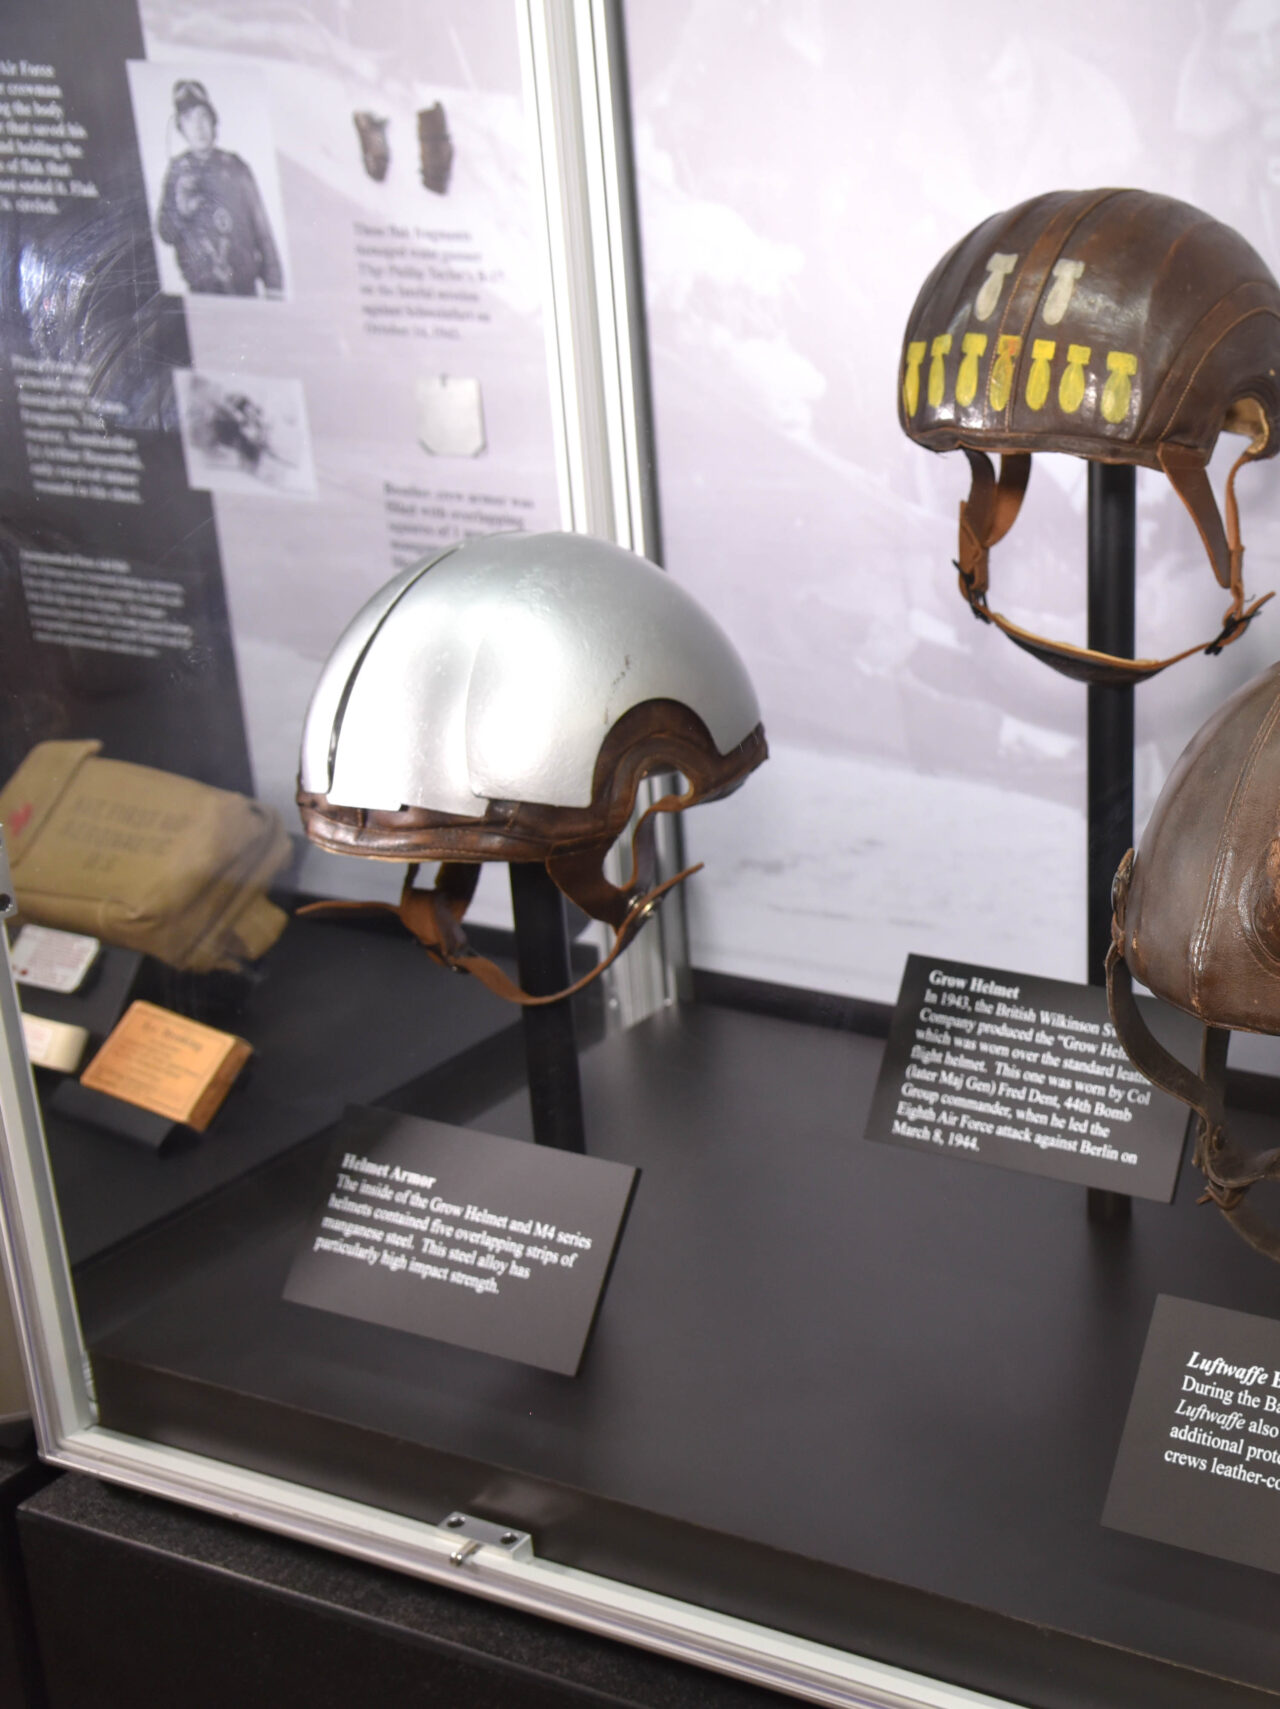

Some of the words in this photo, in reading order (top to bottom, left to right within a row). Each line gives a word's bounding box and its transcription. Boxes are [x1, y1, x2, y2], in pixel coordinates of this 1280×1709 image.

[928, 969, 966, 988] Grow
[970, 977, 1019, 999] Helmet
[919, 1007, 975, 1033] Company
[977, 1022, 1033, 1041] produced
[1035, 1030, 1054, 1046] the
[924, 988, 937, 1003] In
[974, 999, 993, 1014] the
[996, 1003, 1036, 1021] British
[1039, 1010, 1100, 1034] Wilkinson
[915, 1027, 950, 1044] which
[954, 1037, 976, 1050] was
[979, 1042, 1009, 1057] worn
[1011, 1049, 1040, 1062] over
[1040, 1051, 1061, 1067] the
[1062, 1058, 1115, 1077] standard
[905, 1064, 937, 1081] (later
[939, 1070, 963, 1089] Maj
[965, 1076, 996, 1094] Gen)
[997, 1082, 1026, 1100] Fred
[1063, 1096, 1091, 1113] 44th
[1094, 1102, 1132, 1122] Bomb
[910, 1044, 942, 1063] flight
[995, 1061, 1020, 1078] This
[1022, 1071, 1045, 1084] one
[1048, 1076, 1071, 1089] was
[1074, 1081, 1106, 1096] worn
[1108, 1084, 1124, 1101] by
[1127, 1088, 1151, 1105] Col
[891, 1119, 930, 1140] March
[896, 1100, 935, 1121] Eighth
[937, 1111, 957, 1125] Air
[959, 1114, 994, 1134] Force
[995, 1125, 1031, 1142] attack
[1033, 1134, 1077, 1152] against
[1079, 1140, 1118, 1160] Berlin
[1120, 1152, 1137, 1164] on
[900, 1082, 939, 1103] Group
[1016, 1108, 1048, 1124] when
[1050, 1113, 1066, 1128] he
[1068, 1116, 1088, 1133] led
[1090, 1122, 1110, 1138] the
[341, 1152, 390, 1176] Helmet
[390, 1166, 436, 1188] Armor
[327, 1193, 372, 1216] helmets
[373, 1208, 429, 1230] contained
[430, 1218, 454, 1237] five
[454, 1228, 524, 1258] overlapping
[525, 1246, 558, 1265] strips
[559, 1252, 578, 1267] of
[336, 1173, 358, 1191] The
[359, 1183, 393, 1200] inside
[394, 1190, 411, 1203] of
[409, 1192, 429, 1208] the
[429, 1196, 464, 1216] Grow
[464, 1204, 508, 1228] Helmet
[508, 1219, 533, 1234] and
[533, 1221, 555, 1239] M4
[556, 1231, 592, 1249] series
[313, 1236, 378, 1265] particularly
[379, 1252, 407, 1271] high
[408, 1260, 448, 1280] impact
[321, 1216, 384, 1241] manganese
[422, 1238, 446, 1257] This
[448, 1249, 476, 1264] steel
[477, 1255, 507, 1276] alloy
[508, 1261, 530, 1279] has
[1186, 1351, 1268, 1385] Luftwaffe
[1181, 1375, 1233, 1405] During
[1237, 1389, 1260, 1408] the
[1169, 1424, 1244, 1454] additional
[1174, 1398, 1246, 1430] Luftwaffe
[1248, 1418, 1279, 1437] also
[1164, 1450, 1207, 1470] crews
